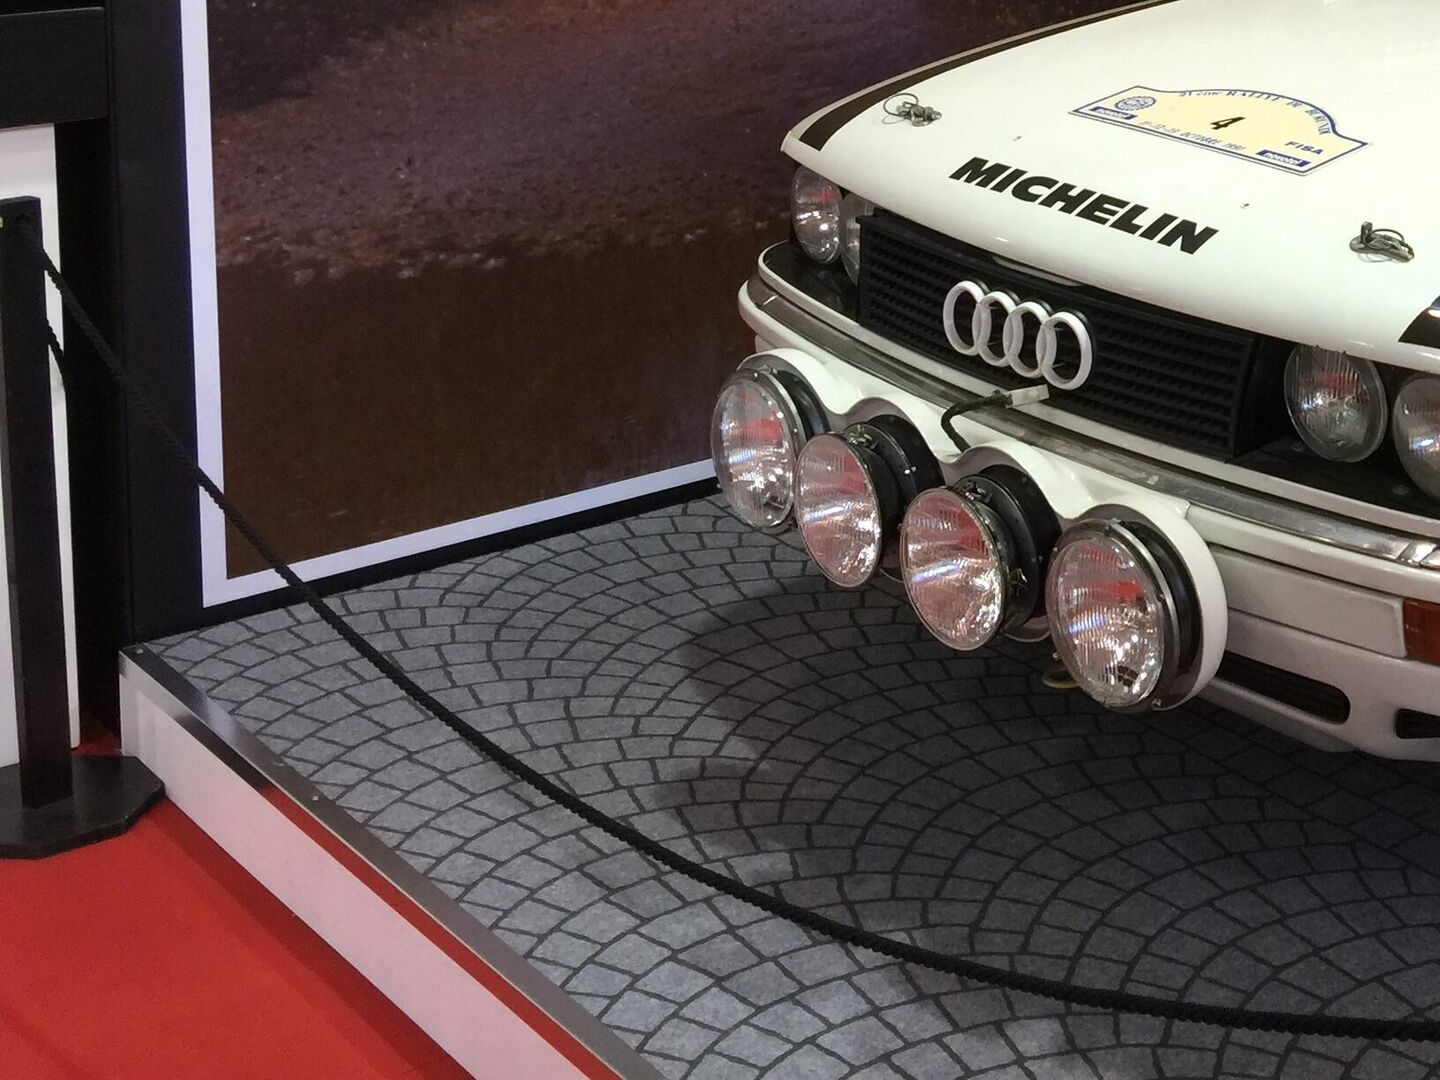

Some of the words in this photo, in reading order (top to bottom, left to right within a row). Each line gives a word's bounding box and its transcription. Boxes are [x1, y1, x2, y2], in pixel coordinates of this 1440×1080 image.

[1209, 116, 1246, 131] 4
[1284, 140, 1325, 155] FISA
[949, 156, 1219, 255] MICHELIN
